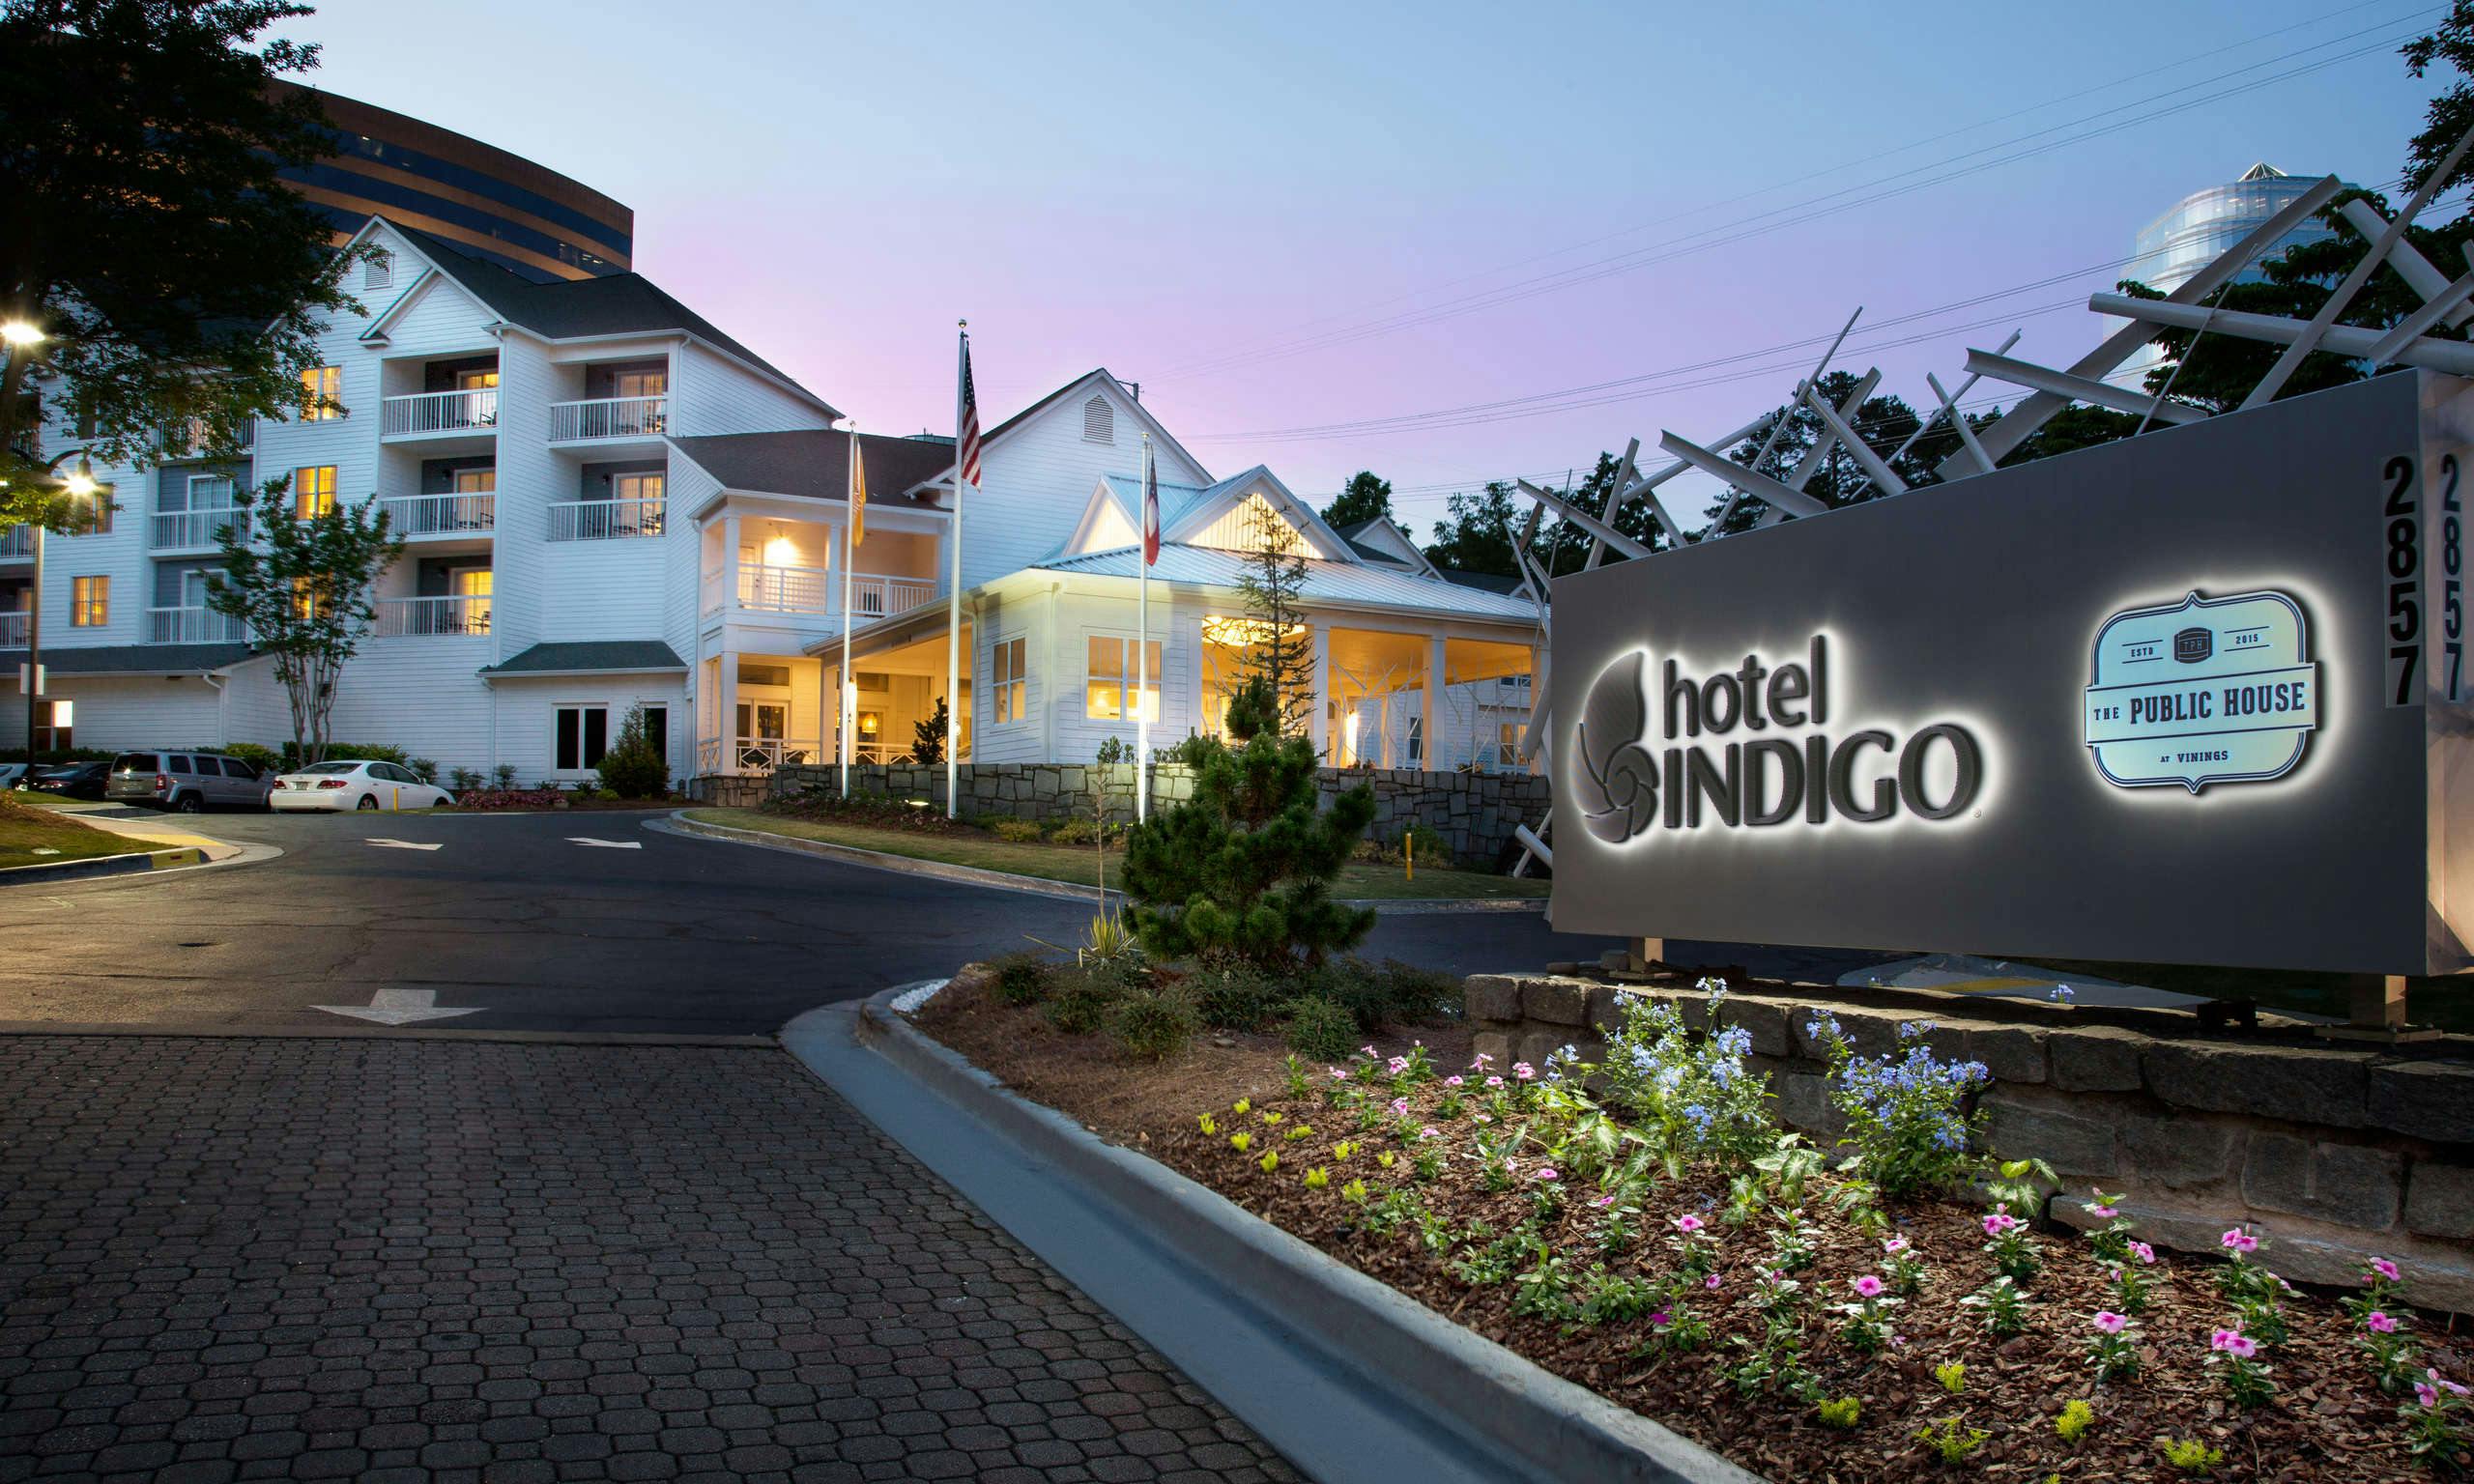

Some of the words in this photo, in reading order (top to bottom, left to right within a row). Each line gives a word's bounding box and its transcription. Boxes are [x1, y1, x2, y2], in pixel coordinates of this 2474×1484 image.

[2383, 456, 2419, 704] 28857
[2441, 454, 2461, 700] 28857
[2131, 647, 2154, 657] ESTD
[2183, 638, 2202, 650] TPH
[2235, 634, 2258, 644] 2015
[1663, 634, 1826, 739] hotel
[2094, 707, 2119, 721] THE
[2130, 692, 2212, 724] PUBLIC
[2224, 682, 2305, 717] HOUSE
[1663, 725, 1983, 829] INDIGO
[2177, 751, 2229, 763] VININGS
